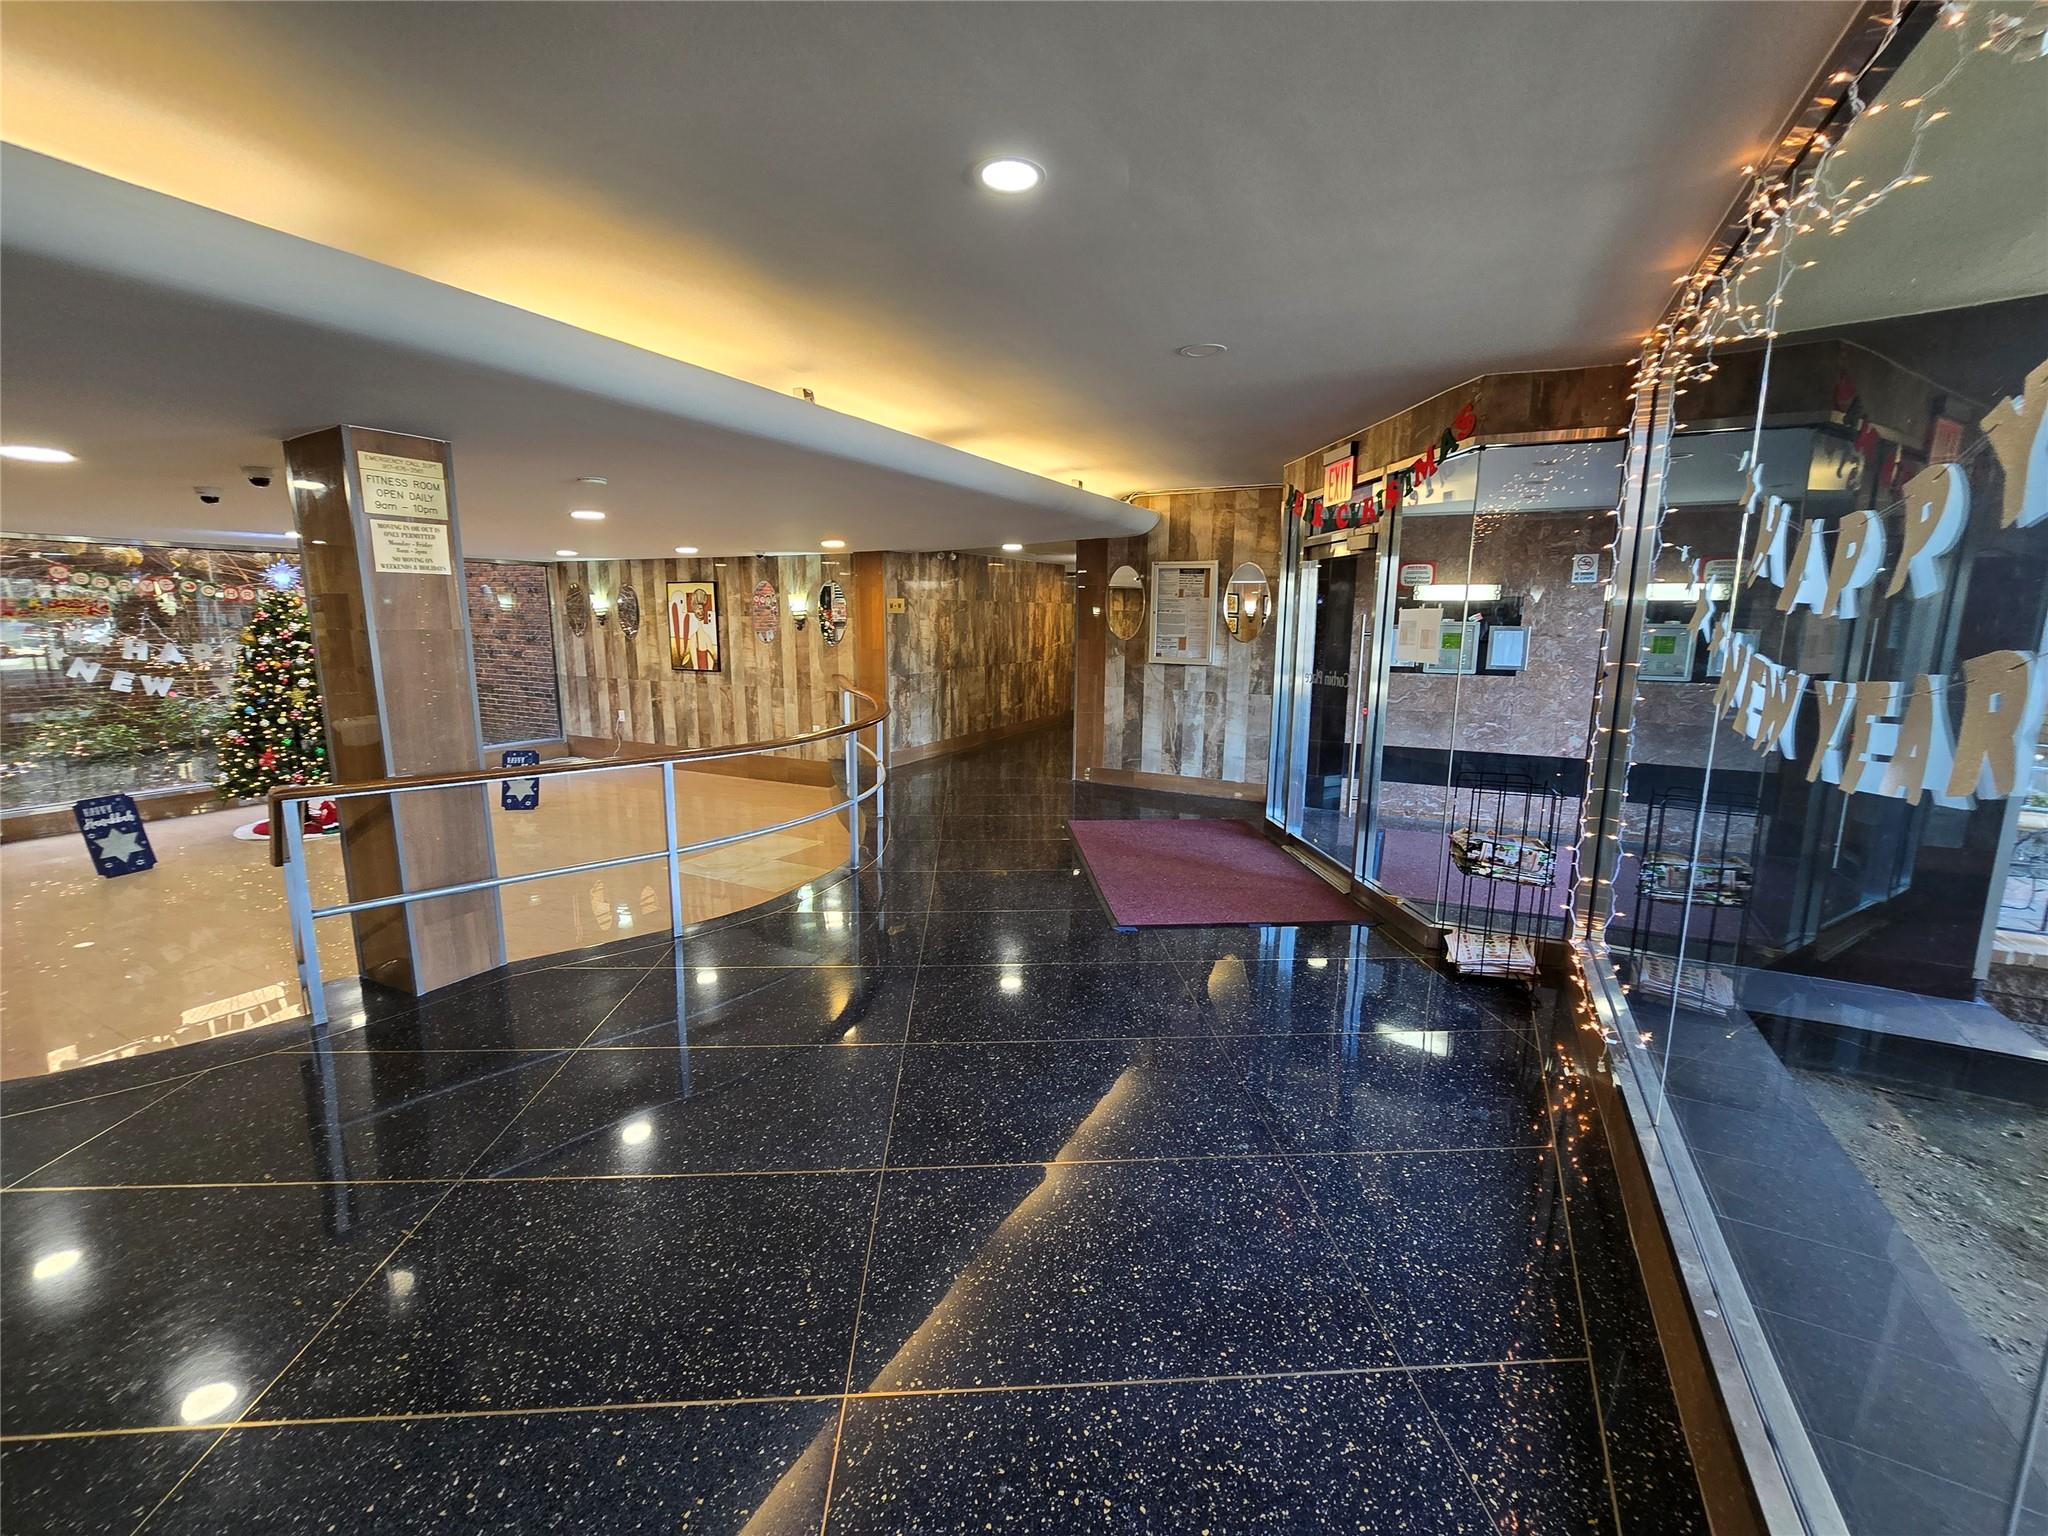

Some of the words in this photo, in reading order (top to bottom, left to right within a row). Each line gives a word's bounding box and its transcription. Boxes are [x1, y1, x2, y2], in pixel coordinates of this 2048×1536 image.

[366, 474, 409, 488] FITNESS
[413, 480, 441, 491] ROOM
[1328, 461, 1351, 503] EXIT
[376, 488, 405, 500] OPEN
[409, 492, 435, 503] DAILY
[374, 500, 398, 511] 9am
[413, 504, 438, 515] 10pm
[377, 523, 402, 532] MOVING
[401, 532, 436, 540] PERMITTED
[388, 539, 412, 549] Monday
[416, 541, 433, 549] Friday
[380, 563, 413, 571] WEEKENDS
[418, 564, 447, 572] HOLIDAYS
[65, 656, 175, 698] NEW
[1713, 632, 1800, 758] NEW
[1806, 650, 2030, 806] YEAR
